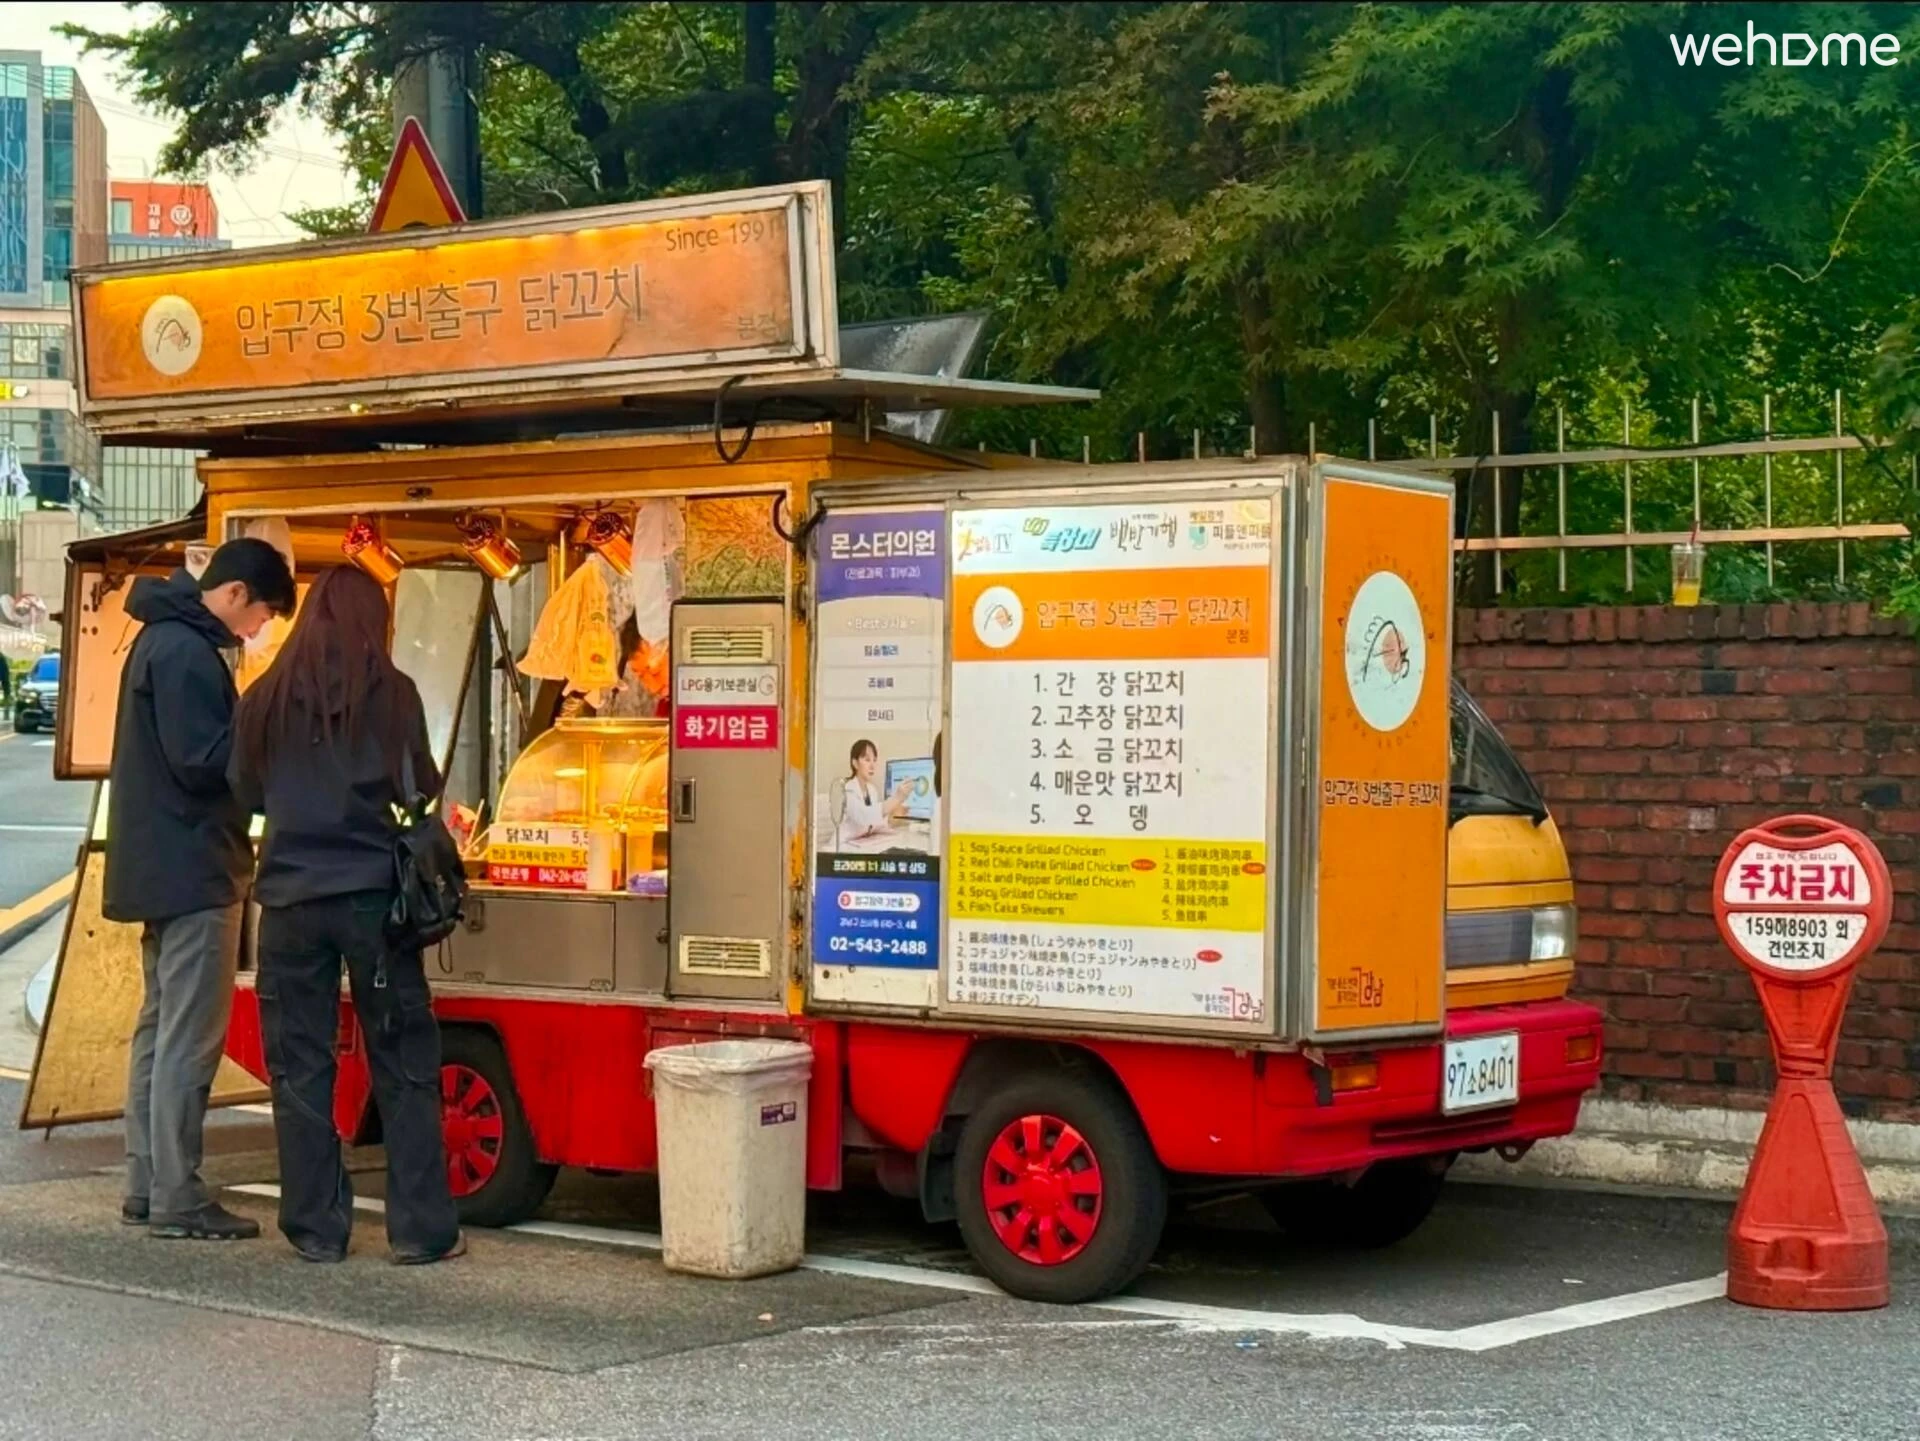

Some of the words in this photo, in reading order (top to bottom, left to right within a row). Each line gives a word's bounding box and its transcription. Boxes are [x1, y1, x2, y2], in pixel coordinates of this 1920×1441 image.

[666, 228, 719, 251] Since
[235, 295, 347, 358] 압구정
[360, 278, 504, 346] 3번출구
[518, 262, 646, 336] 닭꼬치
[830, 529, 936, 559] 몬스터의원
[1036, 600, 1097, 629] 압구정
[1104, 598, 1179, 628] 3번출구
[1188, 596, 1250, 626] 닭꼬치
[681, 677, 757, 693] LPG용기보관실
[1033, 674, 1048, 693] 1.
[1055, 671, 1075, 696] 간
[1096, 671, 1116, 698] 장
[1124, 670, 1184, 697] 닭꼬치
[684, 714, 770, 740] 화기엄금
[1031, 705, 1047, 726] 2.
[1054, 704, 1115, 731] 고추장
[1124, 704, 1184, 731] 닭꼬치
[1031, 738, 1047, 759] 3.
[1053, 738, 1074, 760] 소
[1095, 737, 1116, 763] 금
[1124, 737, 1183, 763] 닭꼬치
[1030, 771, 1046, 791] 4.
[1054, 770, 1114, 796] 매운맛
[1123, 770, 1182, 798] 닭꼬치
[1324, 779, 1359, 805] 압구정
[1360, 781, 1405, 807] 3번출구
[1408, 783, 1442, 808] 닭꼬치
[1030, 804, 1046, 824] 5.
[1073, 803, 1094, 825] 오
[1129, 804, 1149, 831] 뎅
[506, 828, 549, 845] 닭꼬치
[1025, 843, 1061, 856] Grilled
[1063, 844, 1106, 857] Chicken
[970, 857, 989, 869] Red
[1016, 858, 1046, 870] Paste
[1049, 858, 1084, 871] Grilled
[1086, 860, 1131, 872] Chicken
[970, 871, 992, 883] Salt
[994, 872, 1013, 883] and
[1015, 873, 1051, 886] Pepper
[1054, 874, 1089, 887] Grilled
[1092, 875, 1136, 888] Chicken
[1739, 864, 1856, 901] 주차금지
[969, 886, 998, 900] Spicy
[1000, 887, 1035, 900] Grilled
[1037, 889, 1079, 901] Chicken
[969, 901, 991, 912] Fish
[993, 902, 1018, 913] Cake
[1020, 903, 1065, 915] Skewers
[829, 936, 928, 956] 02-543-2488
[1447, 1054, 1515, 1098] 97소8401
